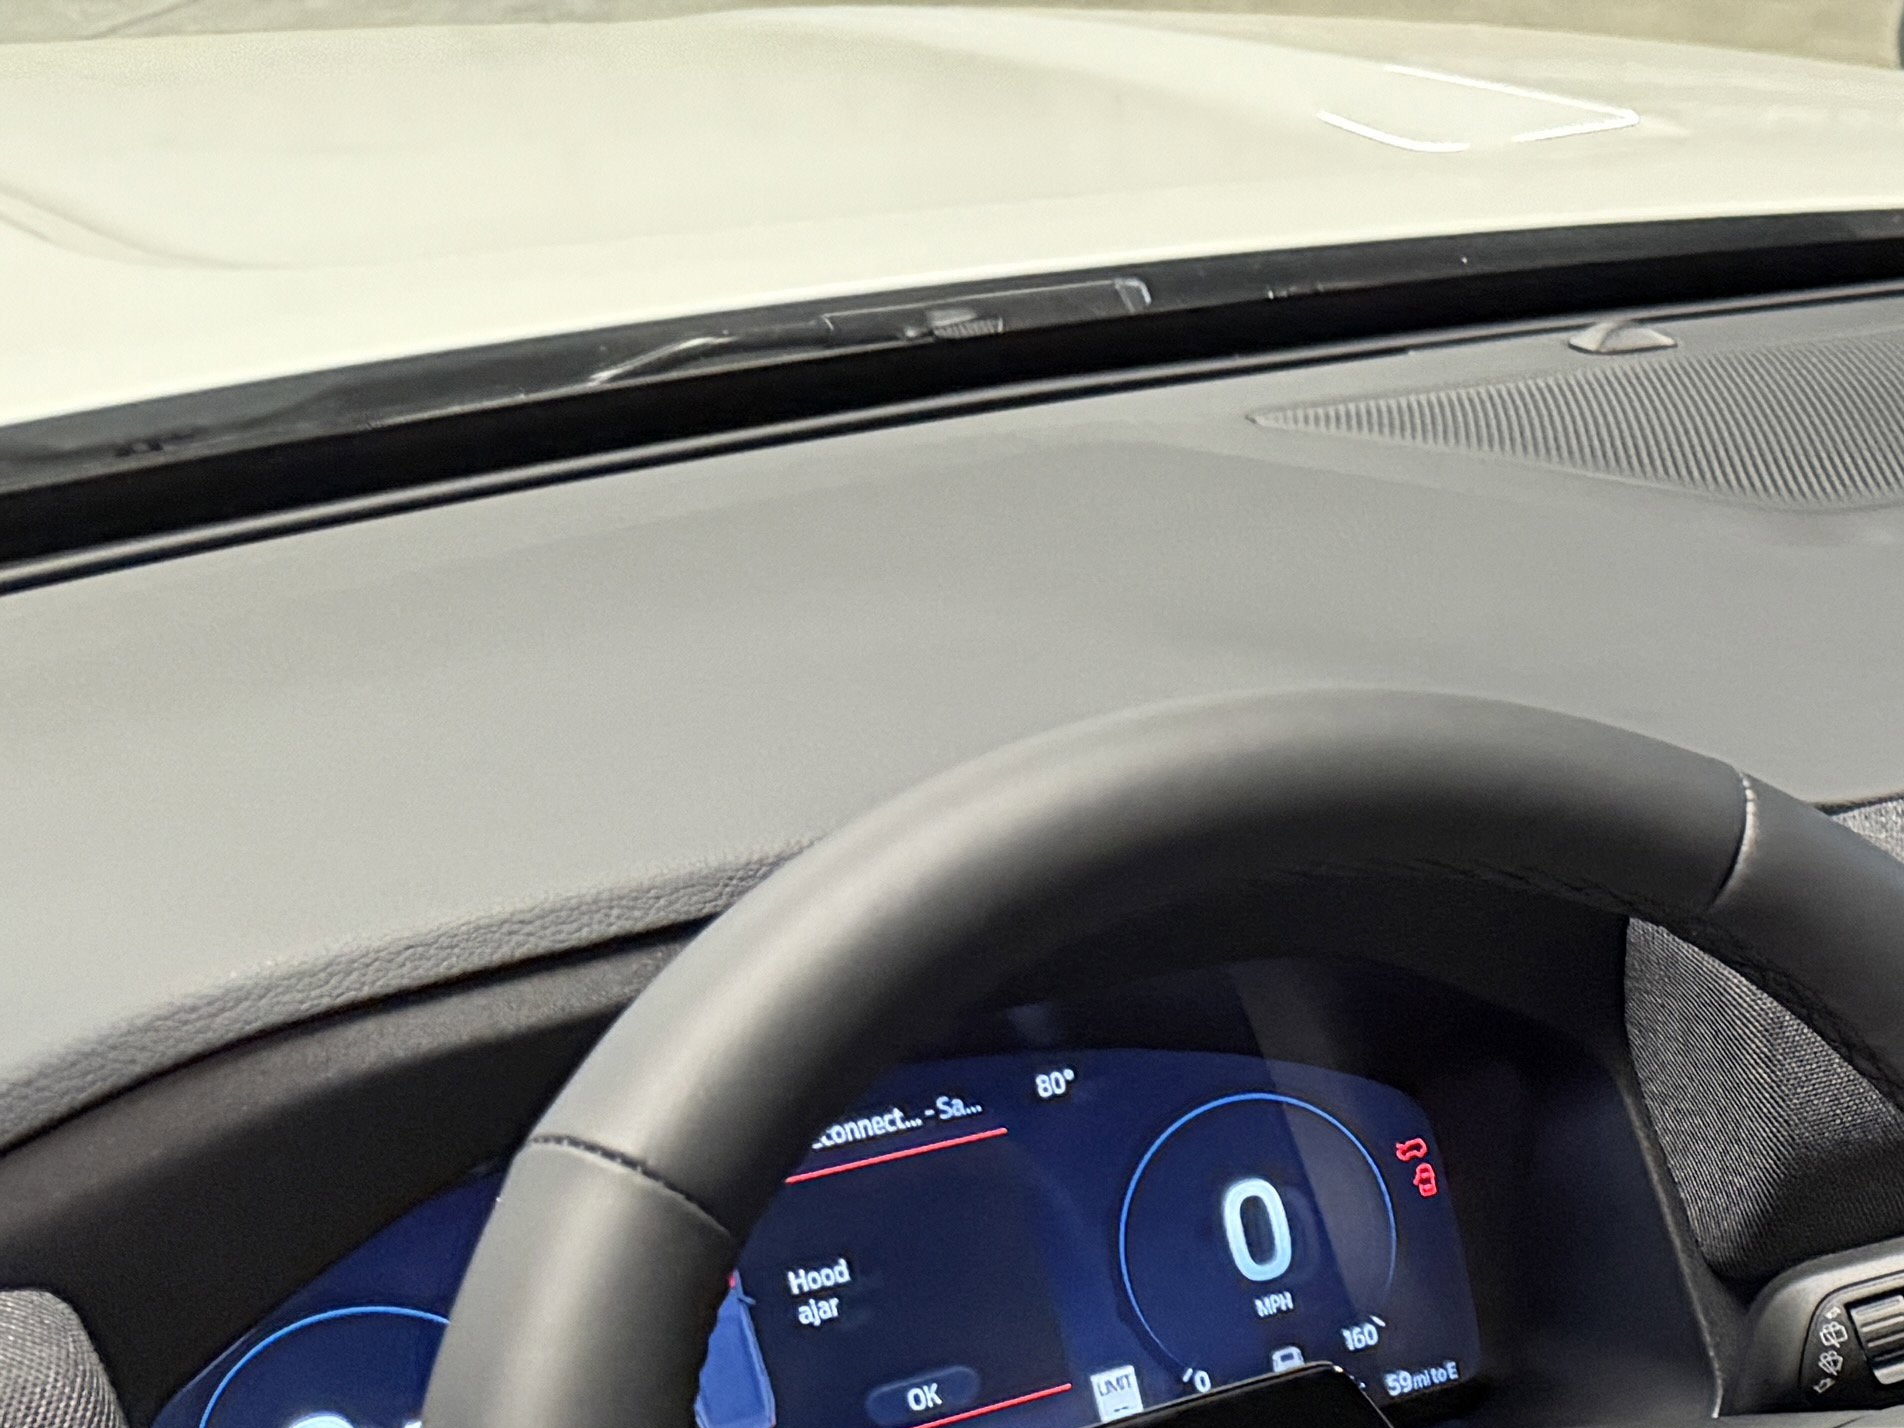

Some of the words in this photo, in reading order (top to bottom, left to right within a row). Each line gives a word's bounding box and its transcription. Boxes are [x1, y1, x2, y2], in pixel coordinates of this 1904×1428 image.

[1223, 1177, 1292, 1282] 0
[787, 1257, 851, 1295] Hood
[798, 1297, 840, 1327] ajar
[1255, 1291, 1294, 1318] MPH
[1342, 1322, 1378, 1350] 160
[1195, 1370, 1211, 1392] 0
[1385, 1369, 1412, 1396] 59
[1430, 1367, 1447, 1384] to
[907, 1383, 943, 1411] OK
